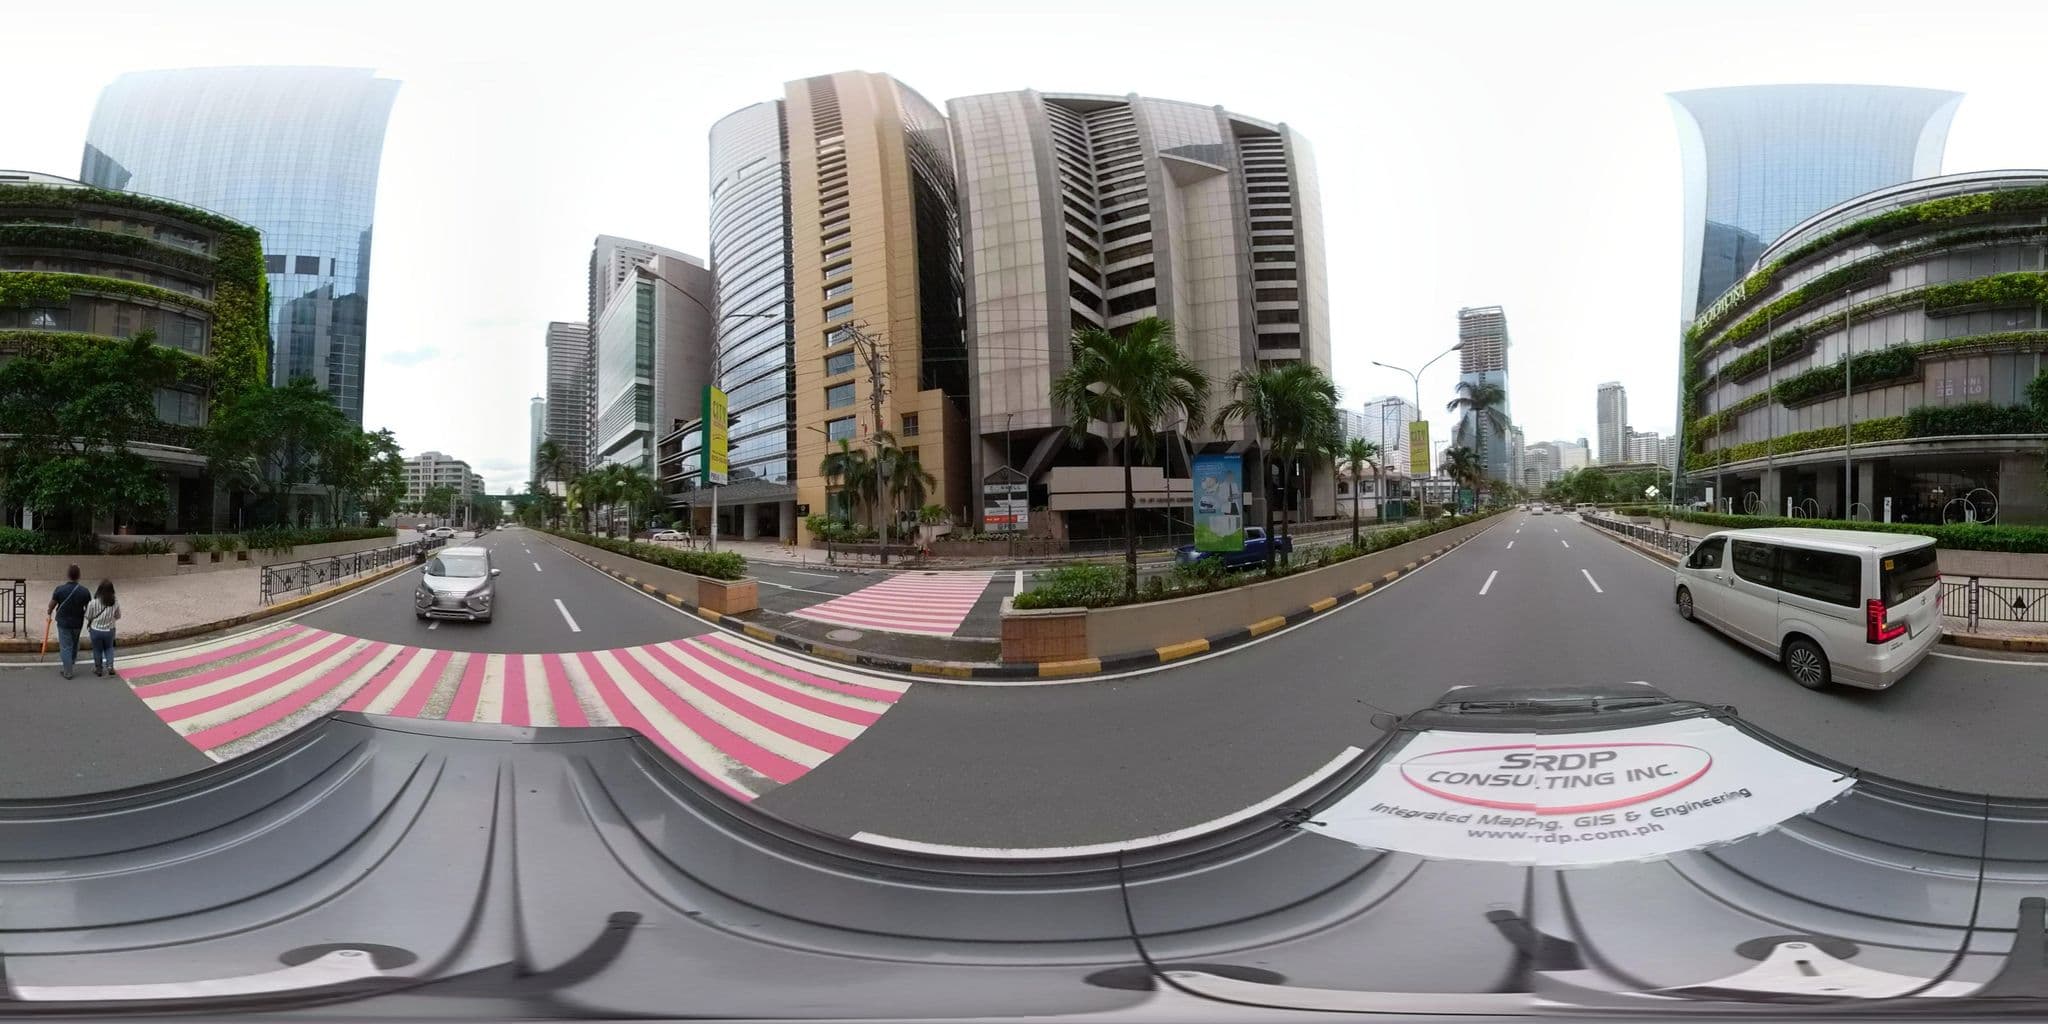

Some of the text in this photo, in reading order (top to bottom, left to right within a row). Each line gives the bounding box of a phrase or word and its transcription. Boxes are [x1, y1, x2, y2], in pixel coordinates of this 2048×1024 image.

[1499, 751, 1618, 771] SRDP
[1427, 764, 1679, 789] CONSUTING INC.
[1370, 802, 1473, 823] Integrated
[1574, 814, 1616, 828] GIS
[1625, 811, 1641, 823] &
[1650, 787, 1753, 818] Engineering
